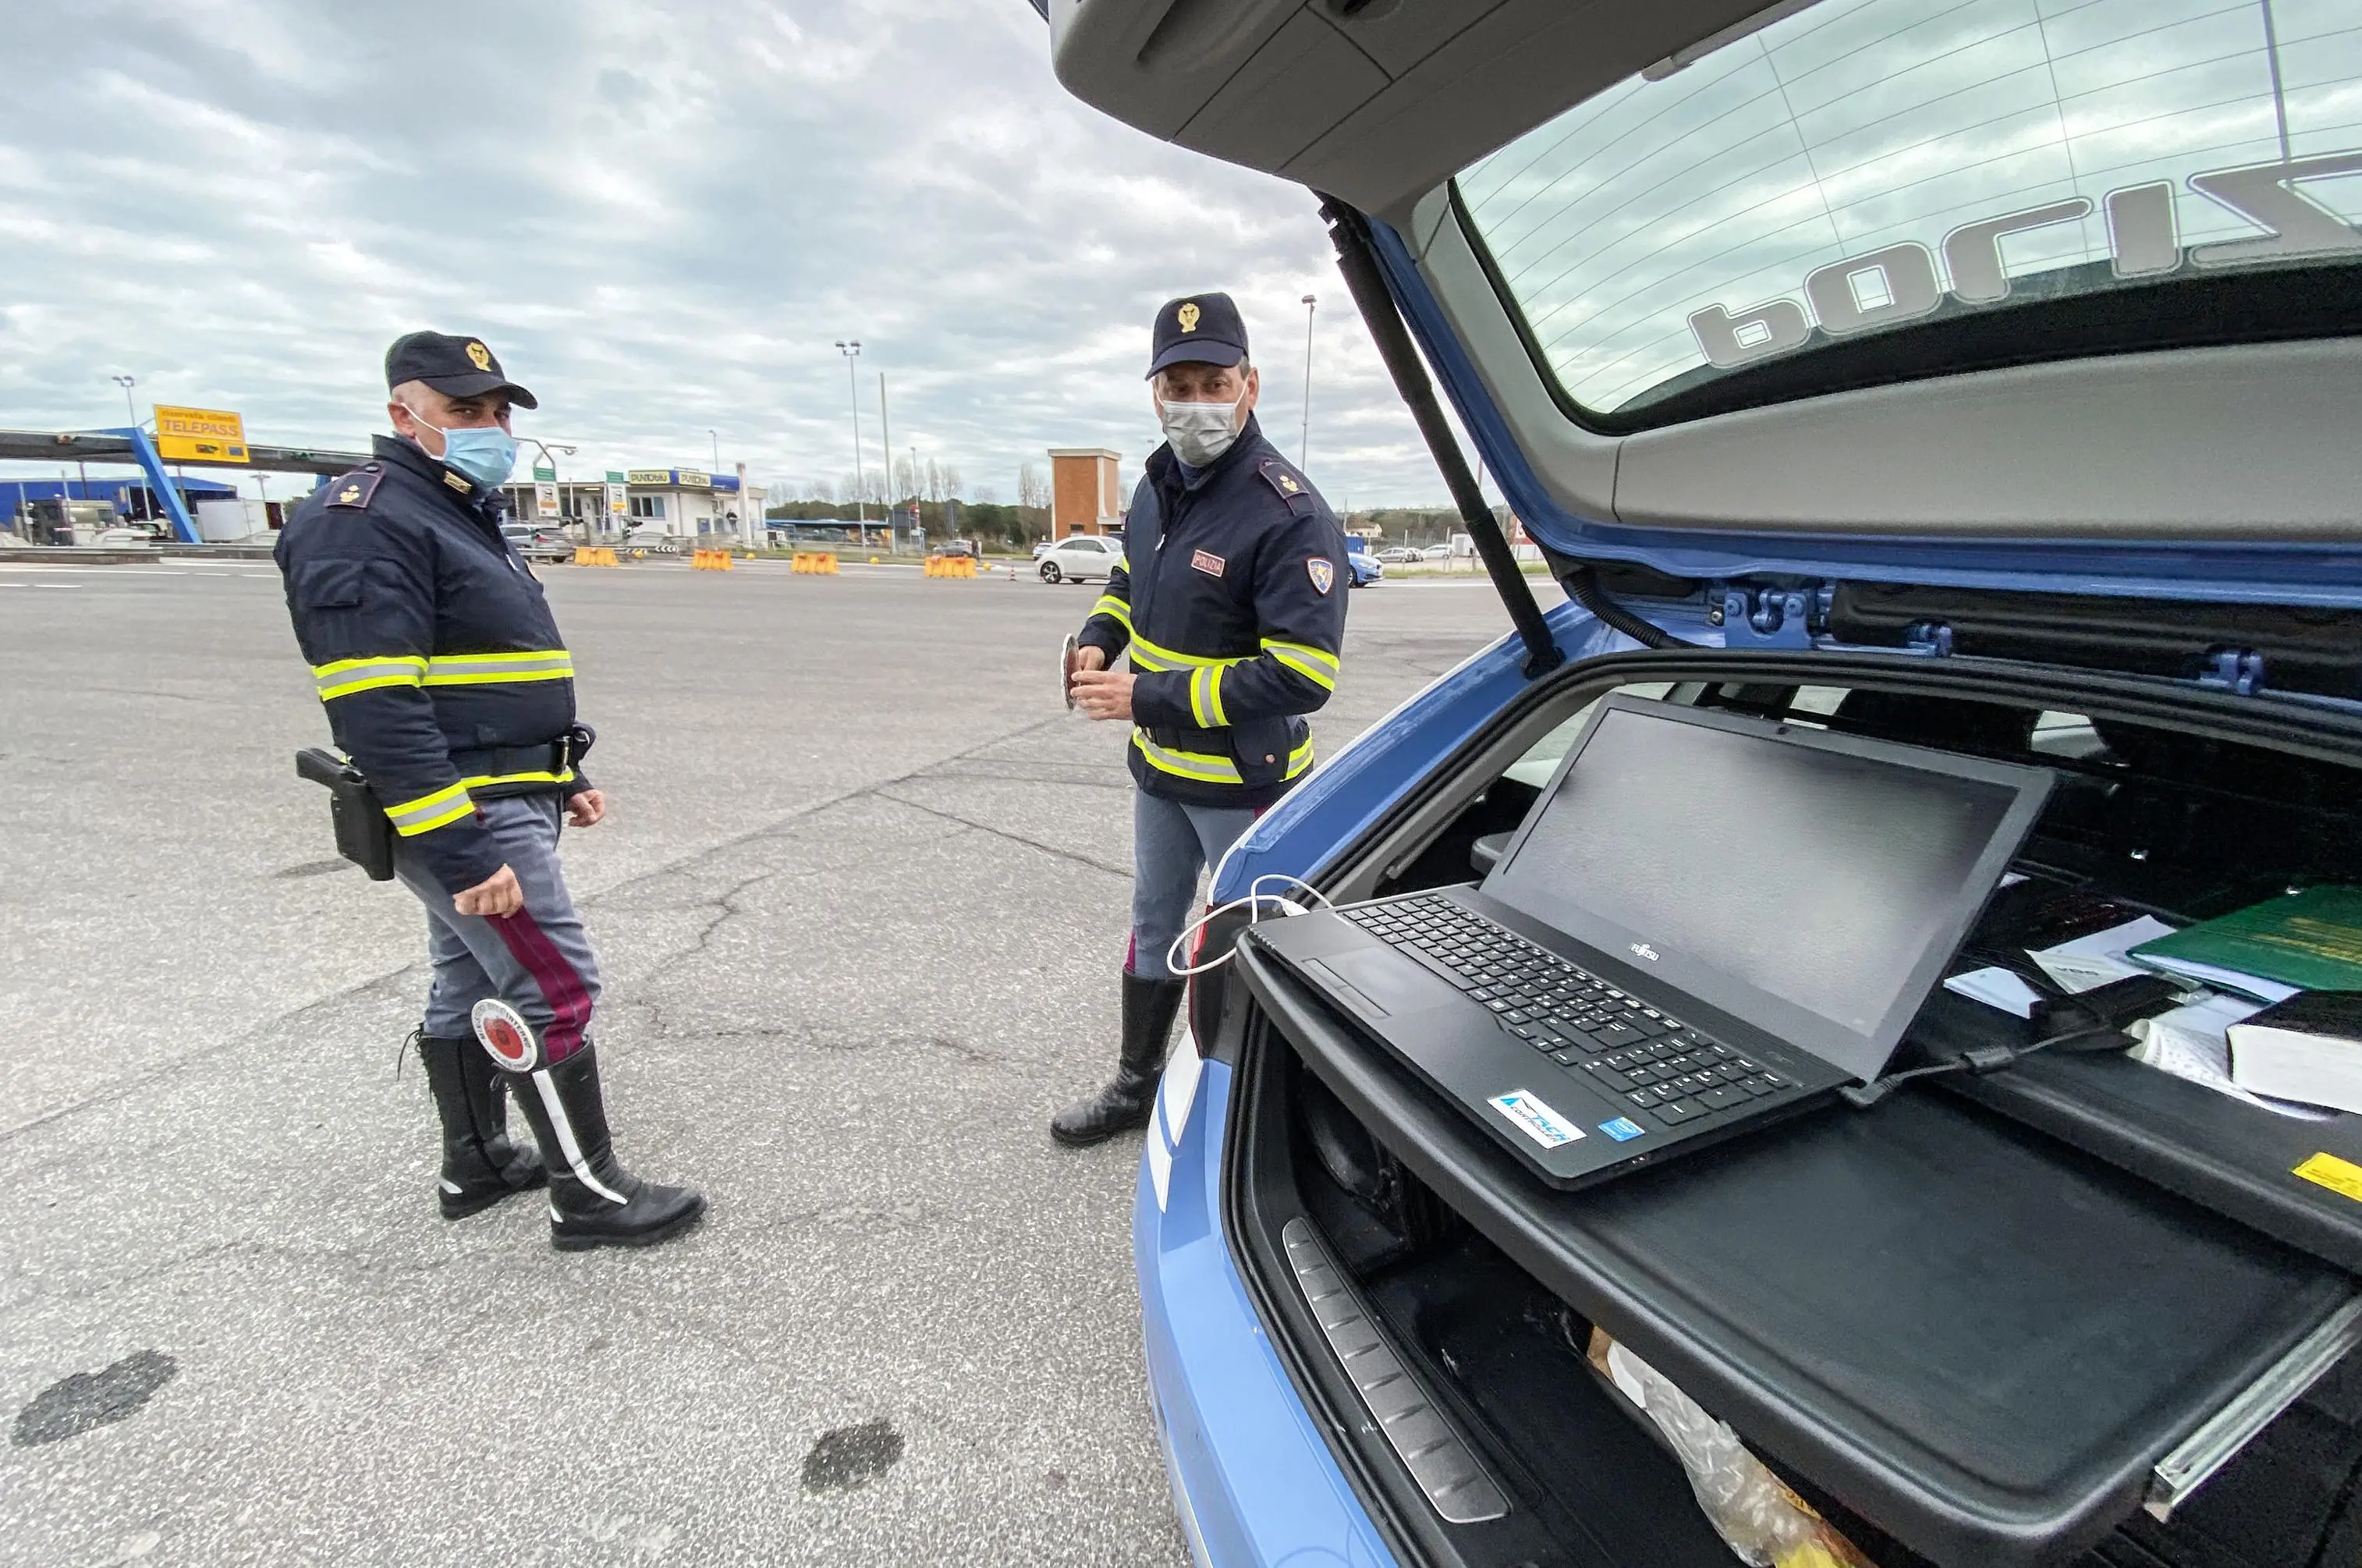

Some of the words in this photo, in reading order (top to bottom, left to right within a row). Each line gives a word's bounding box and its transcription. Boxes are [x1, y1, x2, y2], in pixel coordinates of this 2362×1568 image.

[163, 419, 238, 437] TELEPASS
[1194, 554, 1223, 573] POLIZIA
[1630, 943, 1660, 962] FUJITSU
